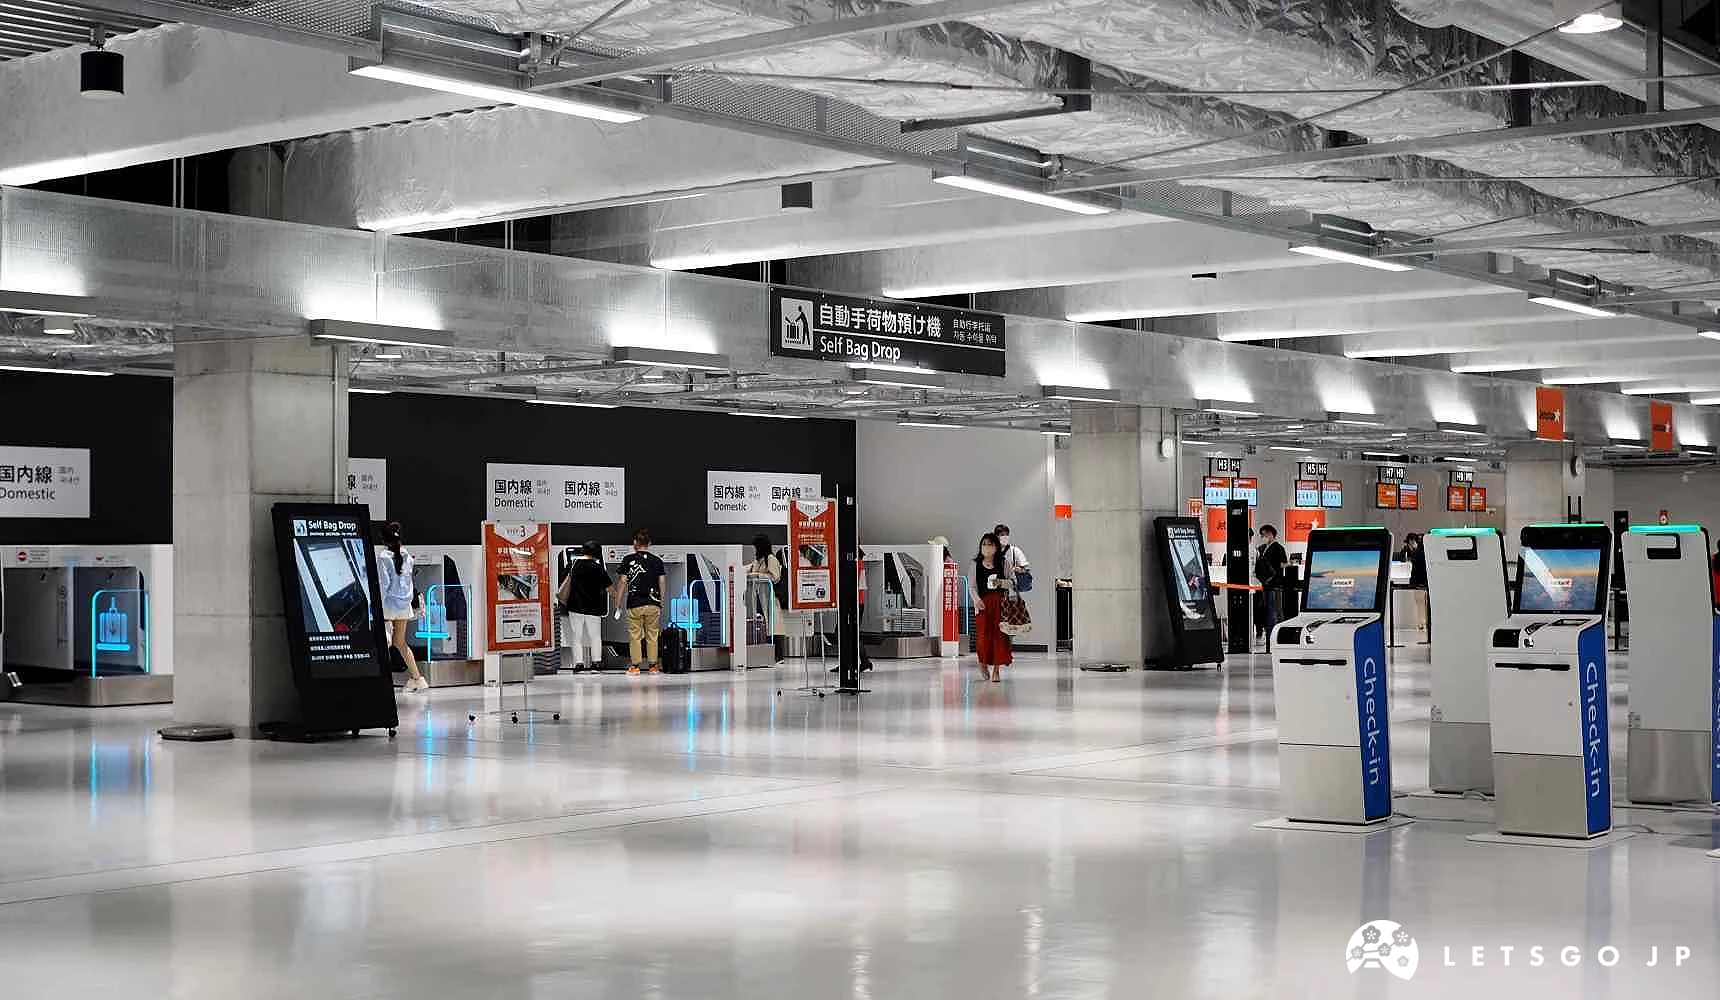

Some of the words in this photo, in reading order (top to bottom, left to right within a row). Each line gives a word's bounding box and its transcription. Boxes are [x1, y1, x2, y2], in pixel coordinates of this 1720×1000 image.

[820, 303, 941, 338] 自動手荷物預け機
[820, 335, 843, 354] Self
[846, 339, 869, 361] Bag
[871, 341, 901, 363] Drop
[1218, 459, 1228, 470] H3
[1307, 463, 1316, 473] H5
[0, 465, 53, 484] 国内線
[1386, 467, 1394, 478] H7
[0, 487, 56, 500] Domestic
[494, 479, 532, 495] 国内線
[564, 480, 601, 496] 国内線
[713, 484, 745, 500] 国内線
[494, 498, 534, 509] Domestic
[564, 498, 602, 510] Domestic
[713, 501, 748, 512] Domestic
[308, 520, 322, 530] Self
[323, 521, 338, 532] Bag
[338, 521, 357, 531] Drop
[1363, 657, 1380, 785] Check-in
[1586, 662, 1602, 797] Check-in
